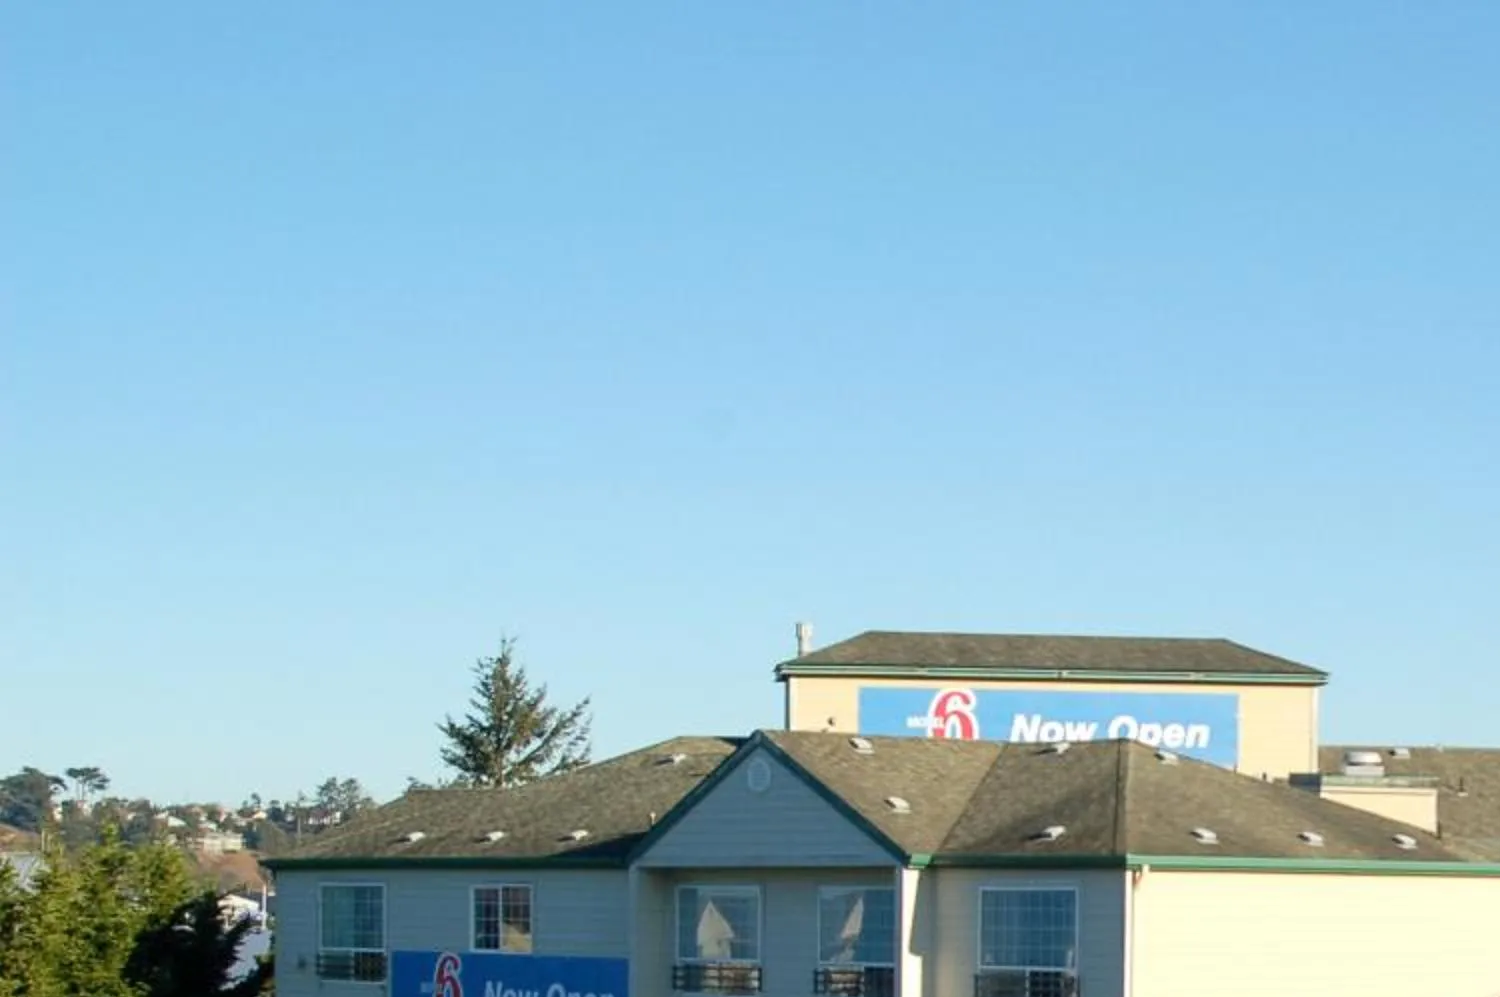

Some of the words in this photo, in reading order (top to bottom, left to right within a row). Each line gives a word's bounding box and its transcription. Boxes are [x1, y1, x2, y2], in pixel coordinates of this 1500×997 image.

[928, 688, 980, 741] 6
[1010, 713, 1098, 743] Now
[1108, 715, 1211, 749] Open
